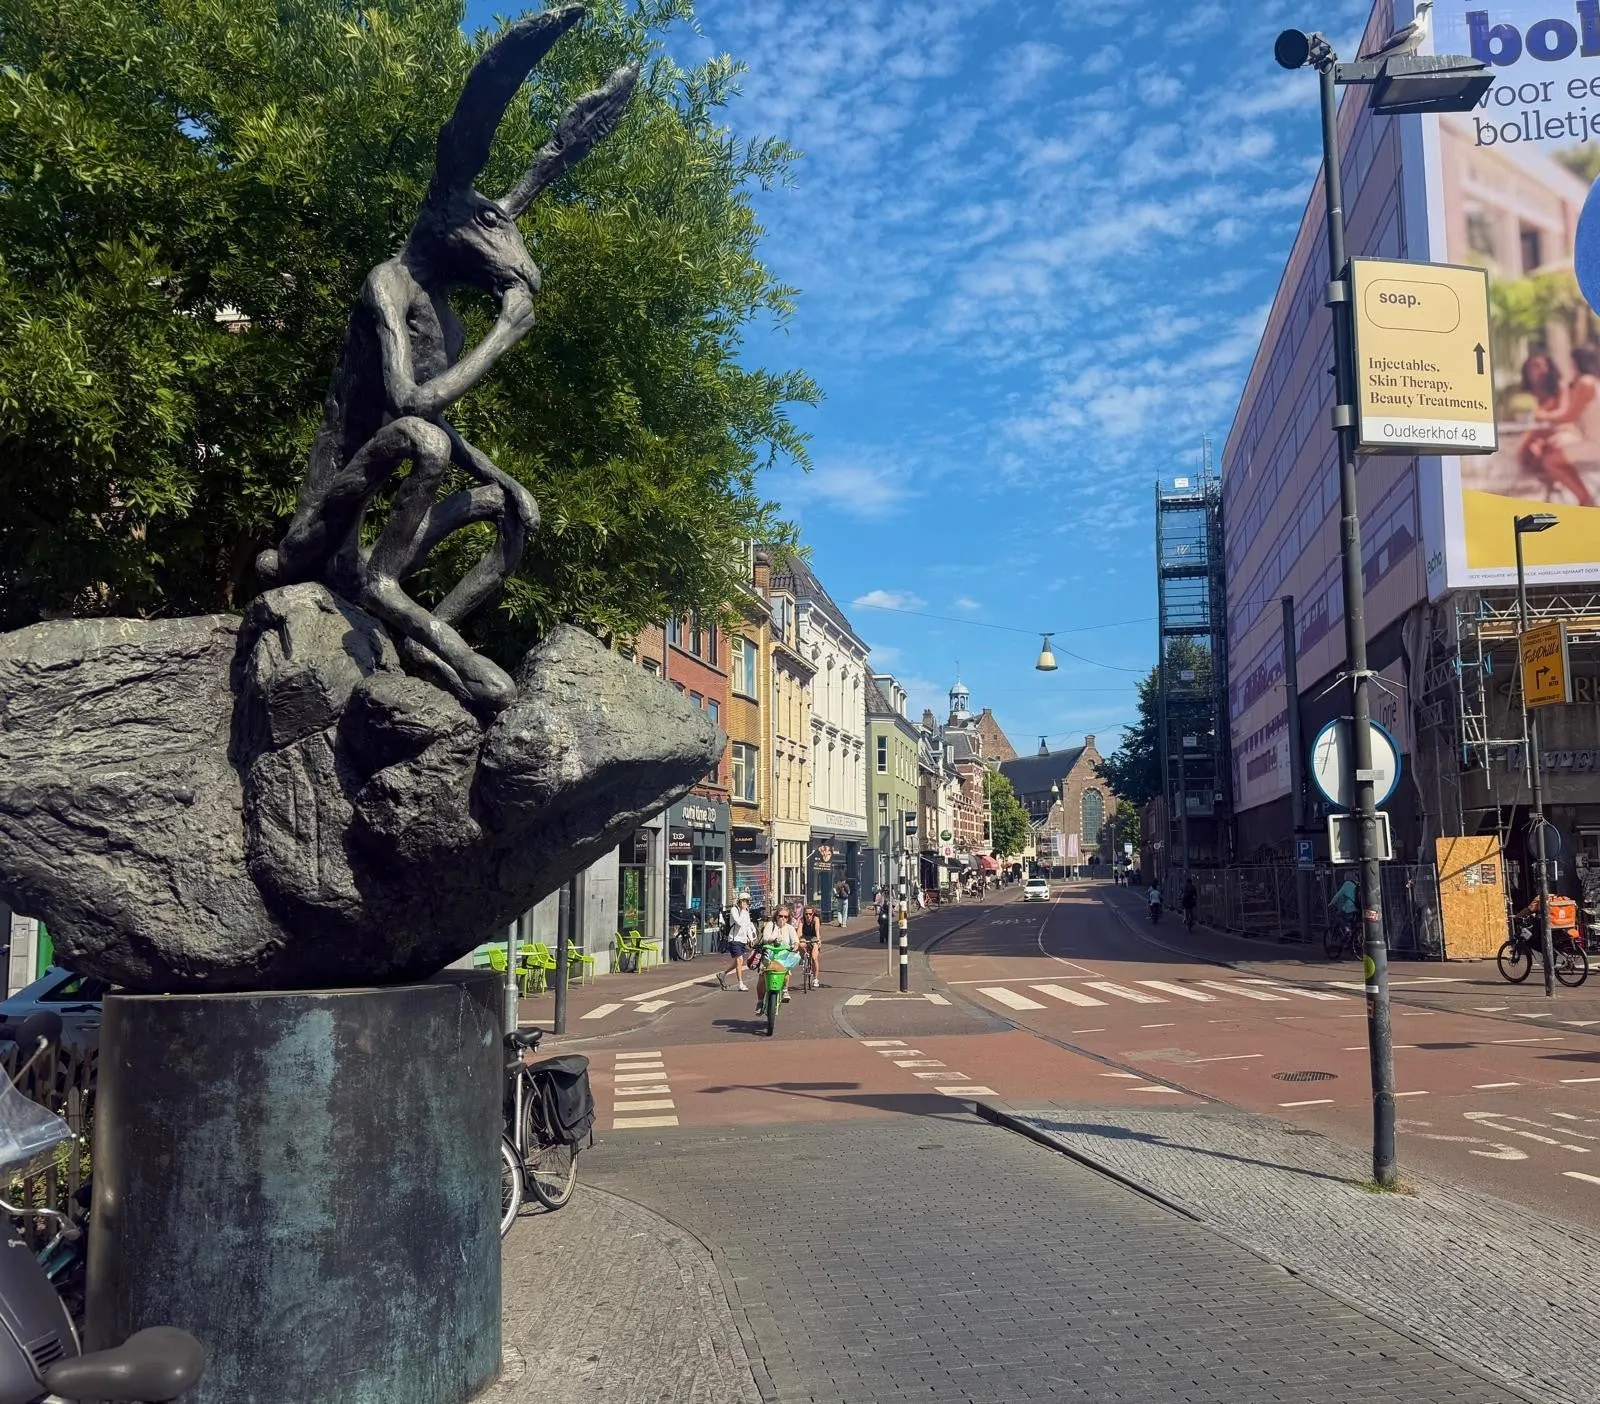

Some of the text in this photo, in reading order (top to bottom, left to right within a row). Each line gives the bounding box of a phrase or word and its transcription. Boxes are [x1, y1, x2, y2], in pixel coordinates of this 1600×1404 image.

[1479, 81, 1555, 109] voor
[1379, 292, 1421, 308] soap.
[1368, 357, 1440, 373] Injectables.
[1368, 374, 1453, 393] Skin Therapy.
[1370, 391, 1488, 411] Beauty Treatments.
[1383, 423, 1477, 441] Oudkerkhof 48
